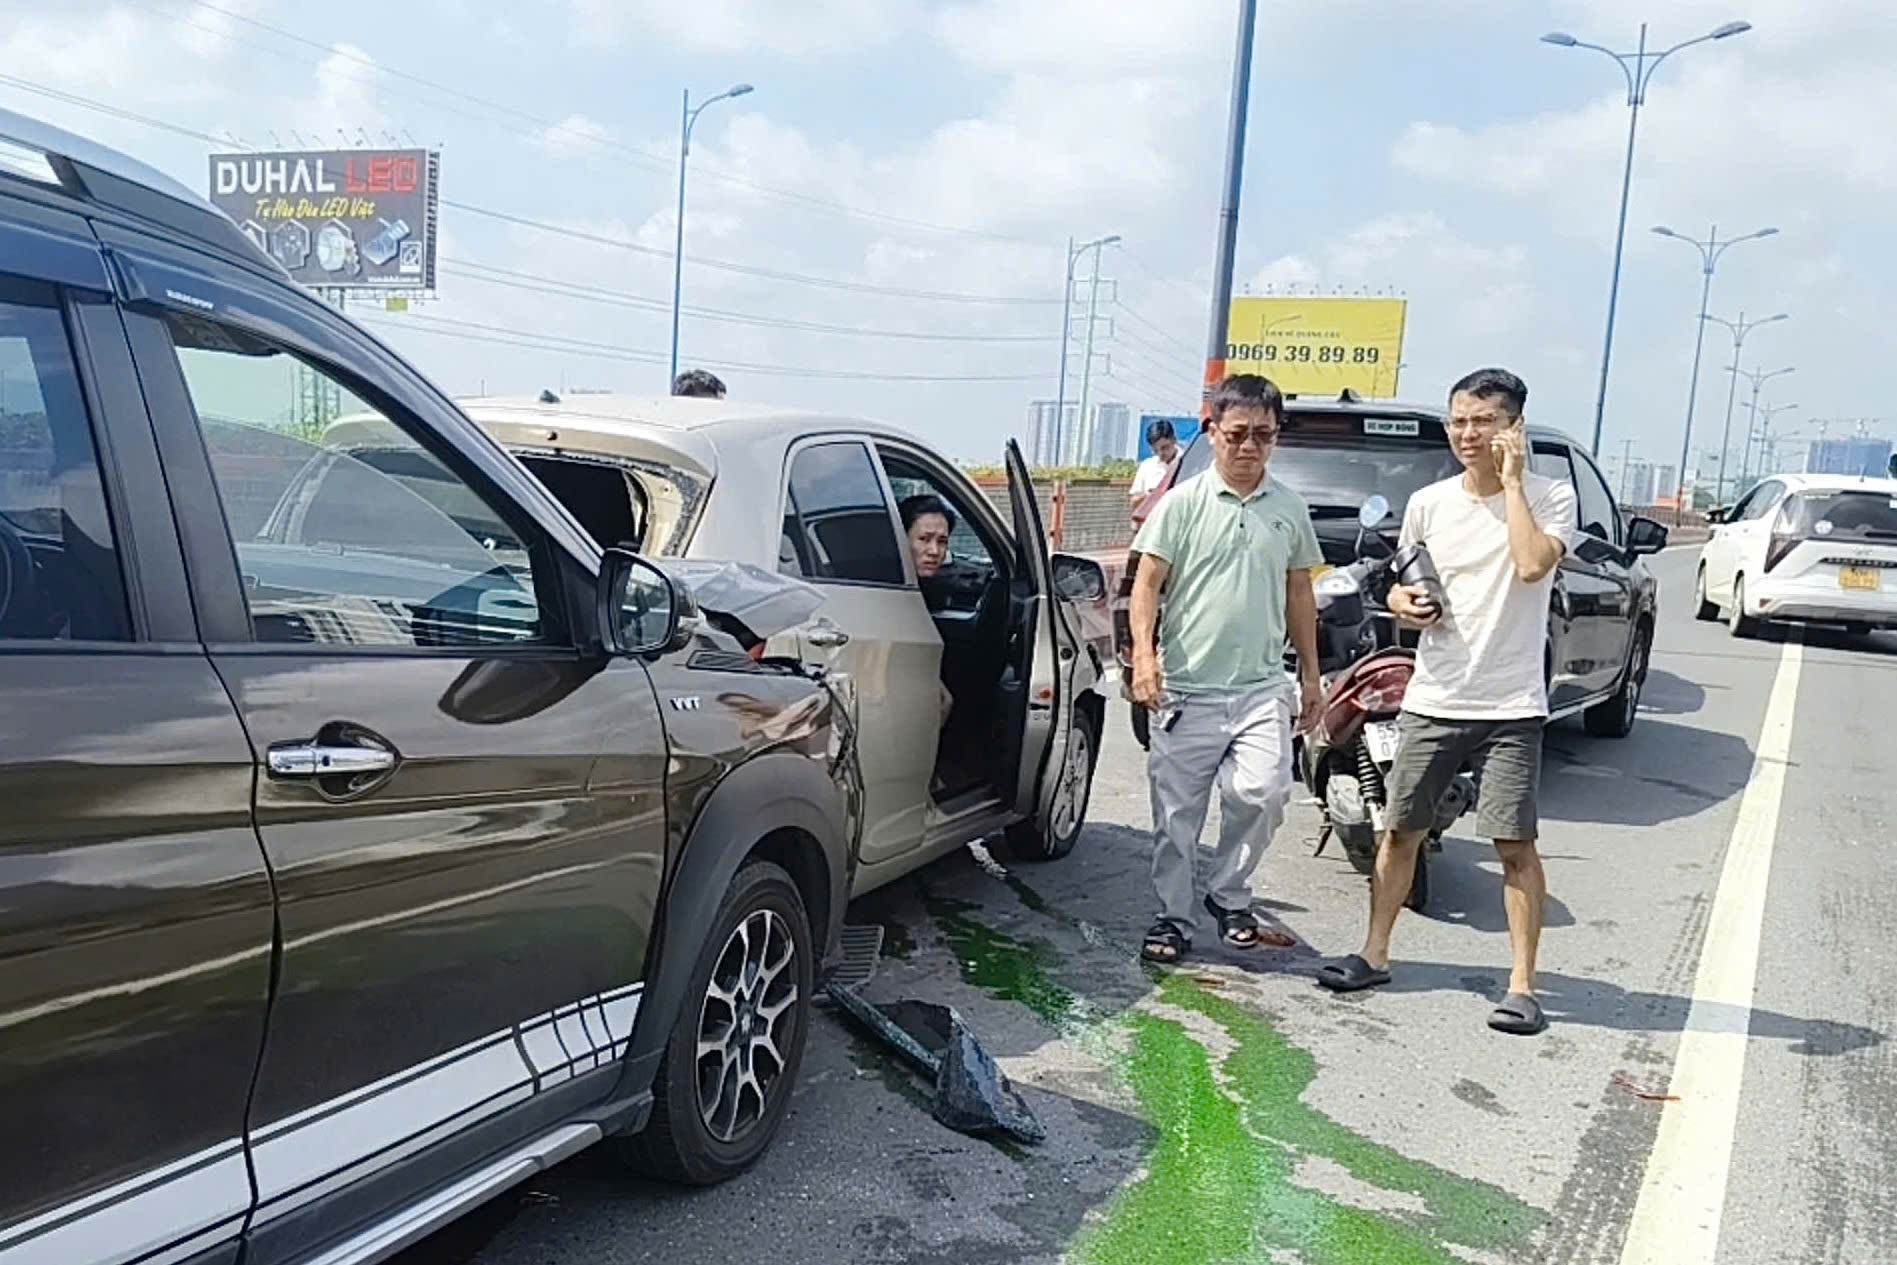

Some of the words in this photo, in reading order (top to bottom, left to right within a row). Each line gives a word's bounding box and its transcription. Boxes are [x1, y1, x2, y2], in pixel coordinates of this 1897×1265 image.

[217, 159, 336, 194] DUHAL
[345, 156, 418, 192] LED
[319, 196, 349, 217] LED
